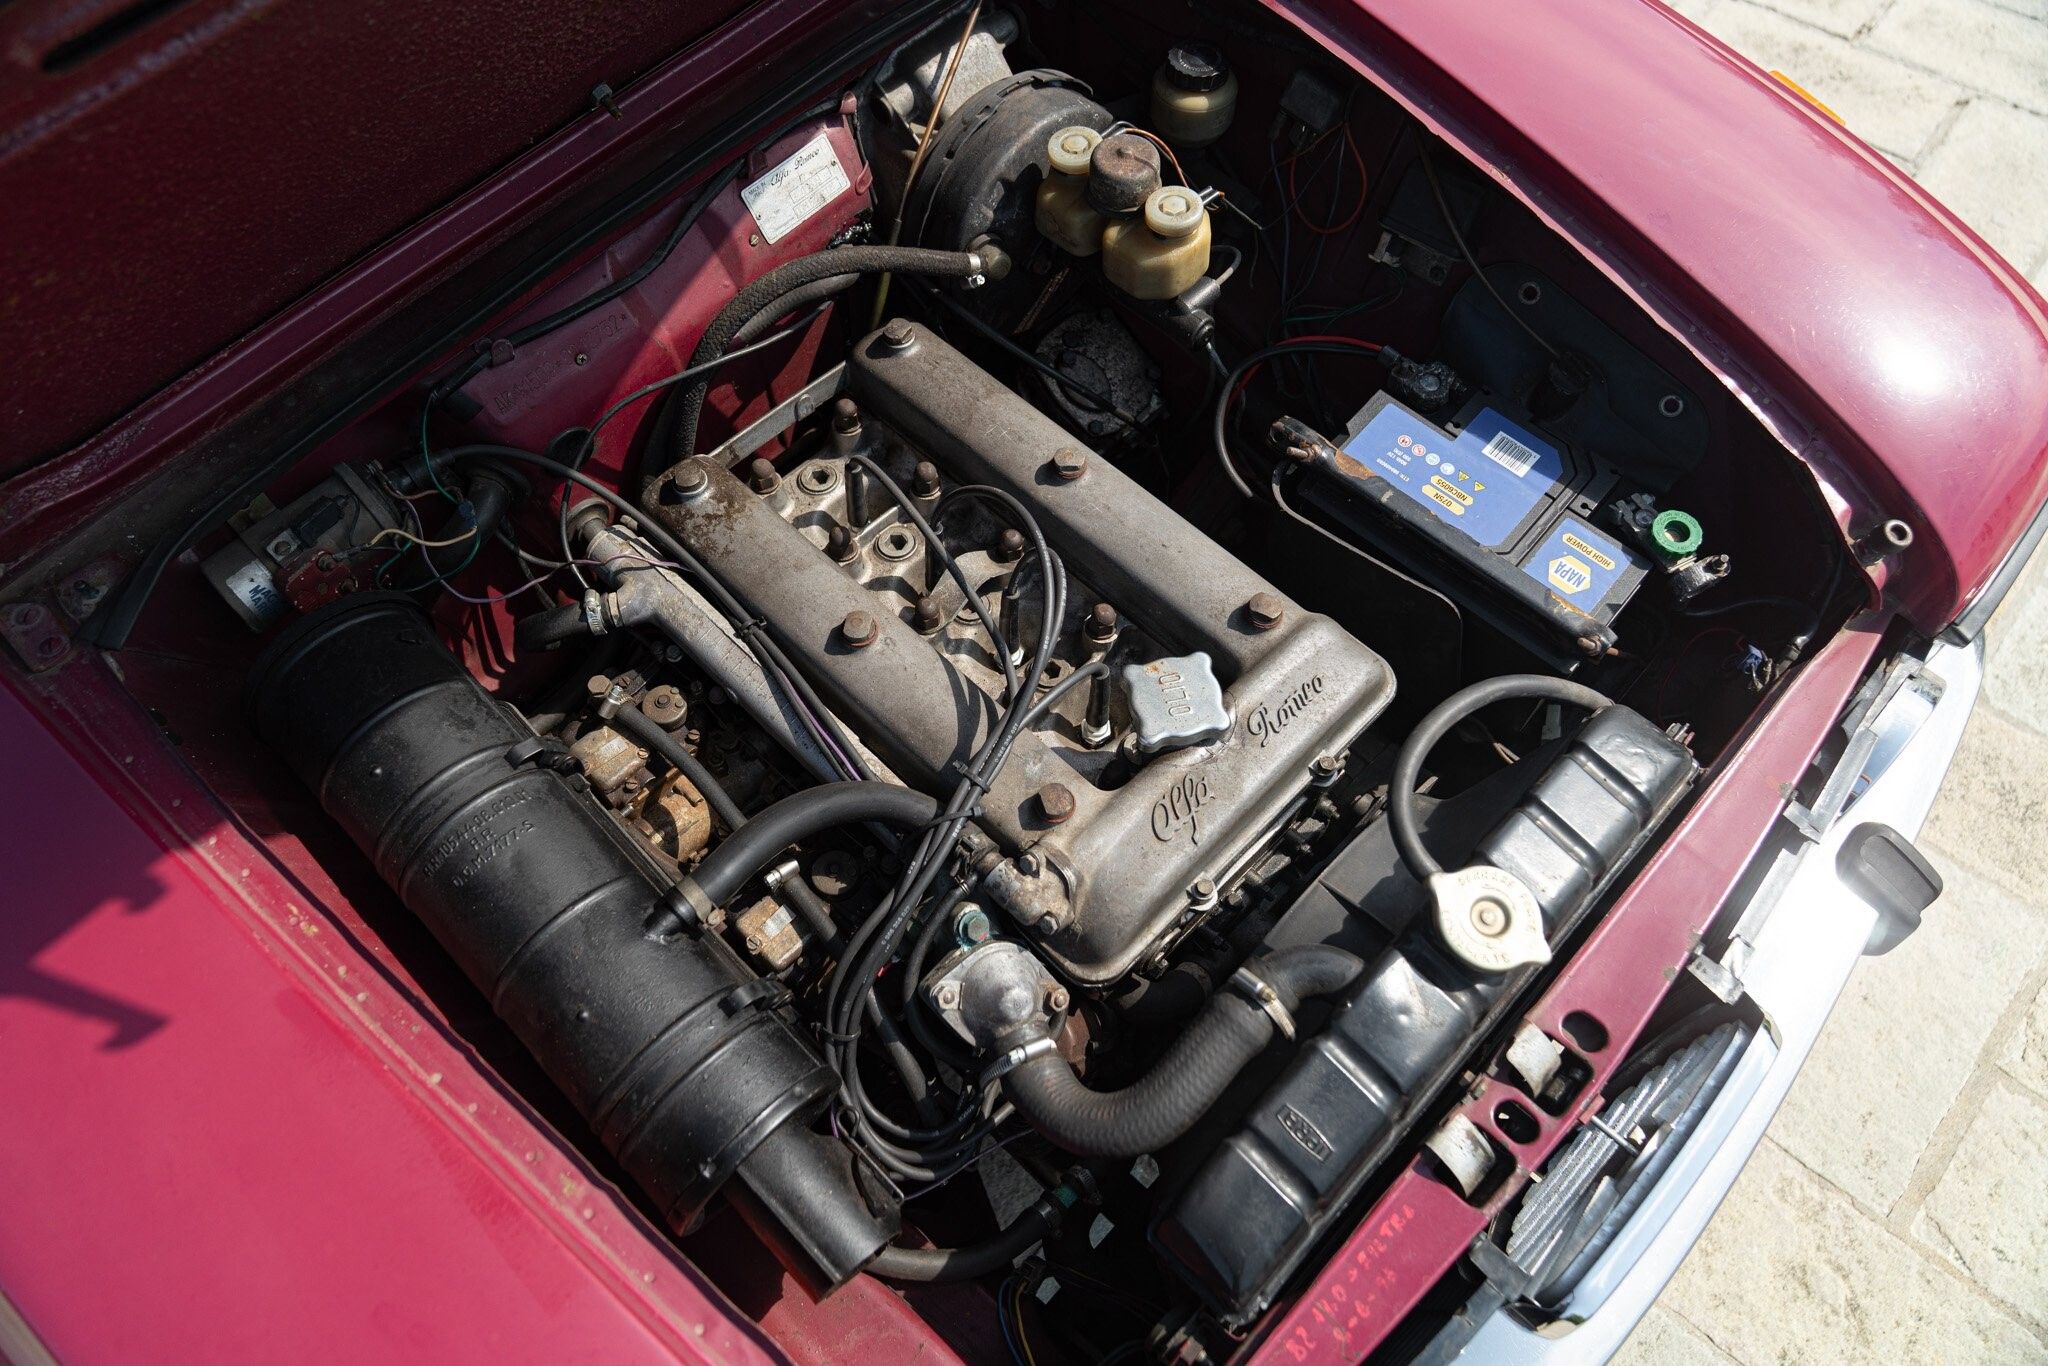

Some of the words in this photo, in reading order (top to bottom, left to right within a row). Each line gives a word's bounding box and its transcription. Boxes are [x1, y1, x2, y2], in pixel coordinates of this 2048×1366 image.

[1435, 478, 1467, 501] NBC6055
[1564, 535, 1592, 555] POWER
[1591, 552, 1611, 568] HIGH
[1552, 560, 1586, 588] NAPA
[1158, 672, 1192, 718] OLIO
[1151, 772, 1215, 846] Alfa
[1247, 674, 1323, 748] Romeo
